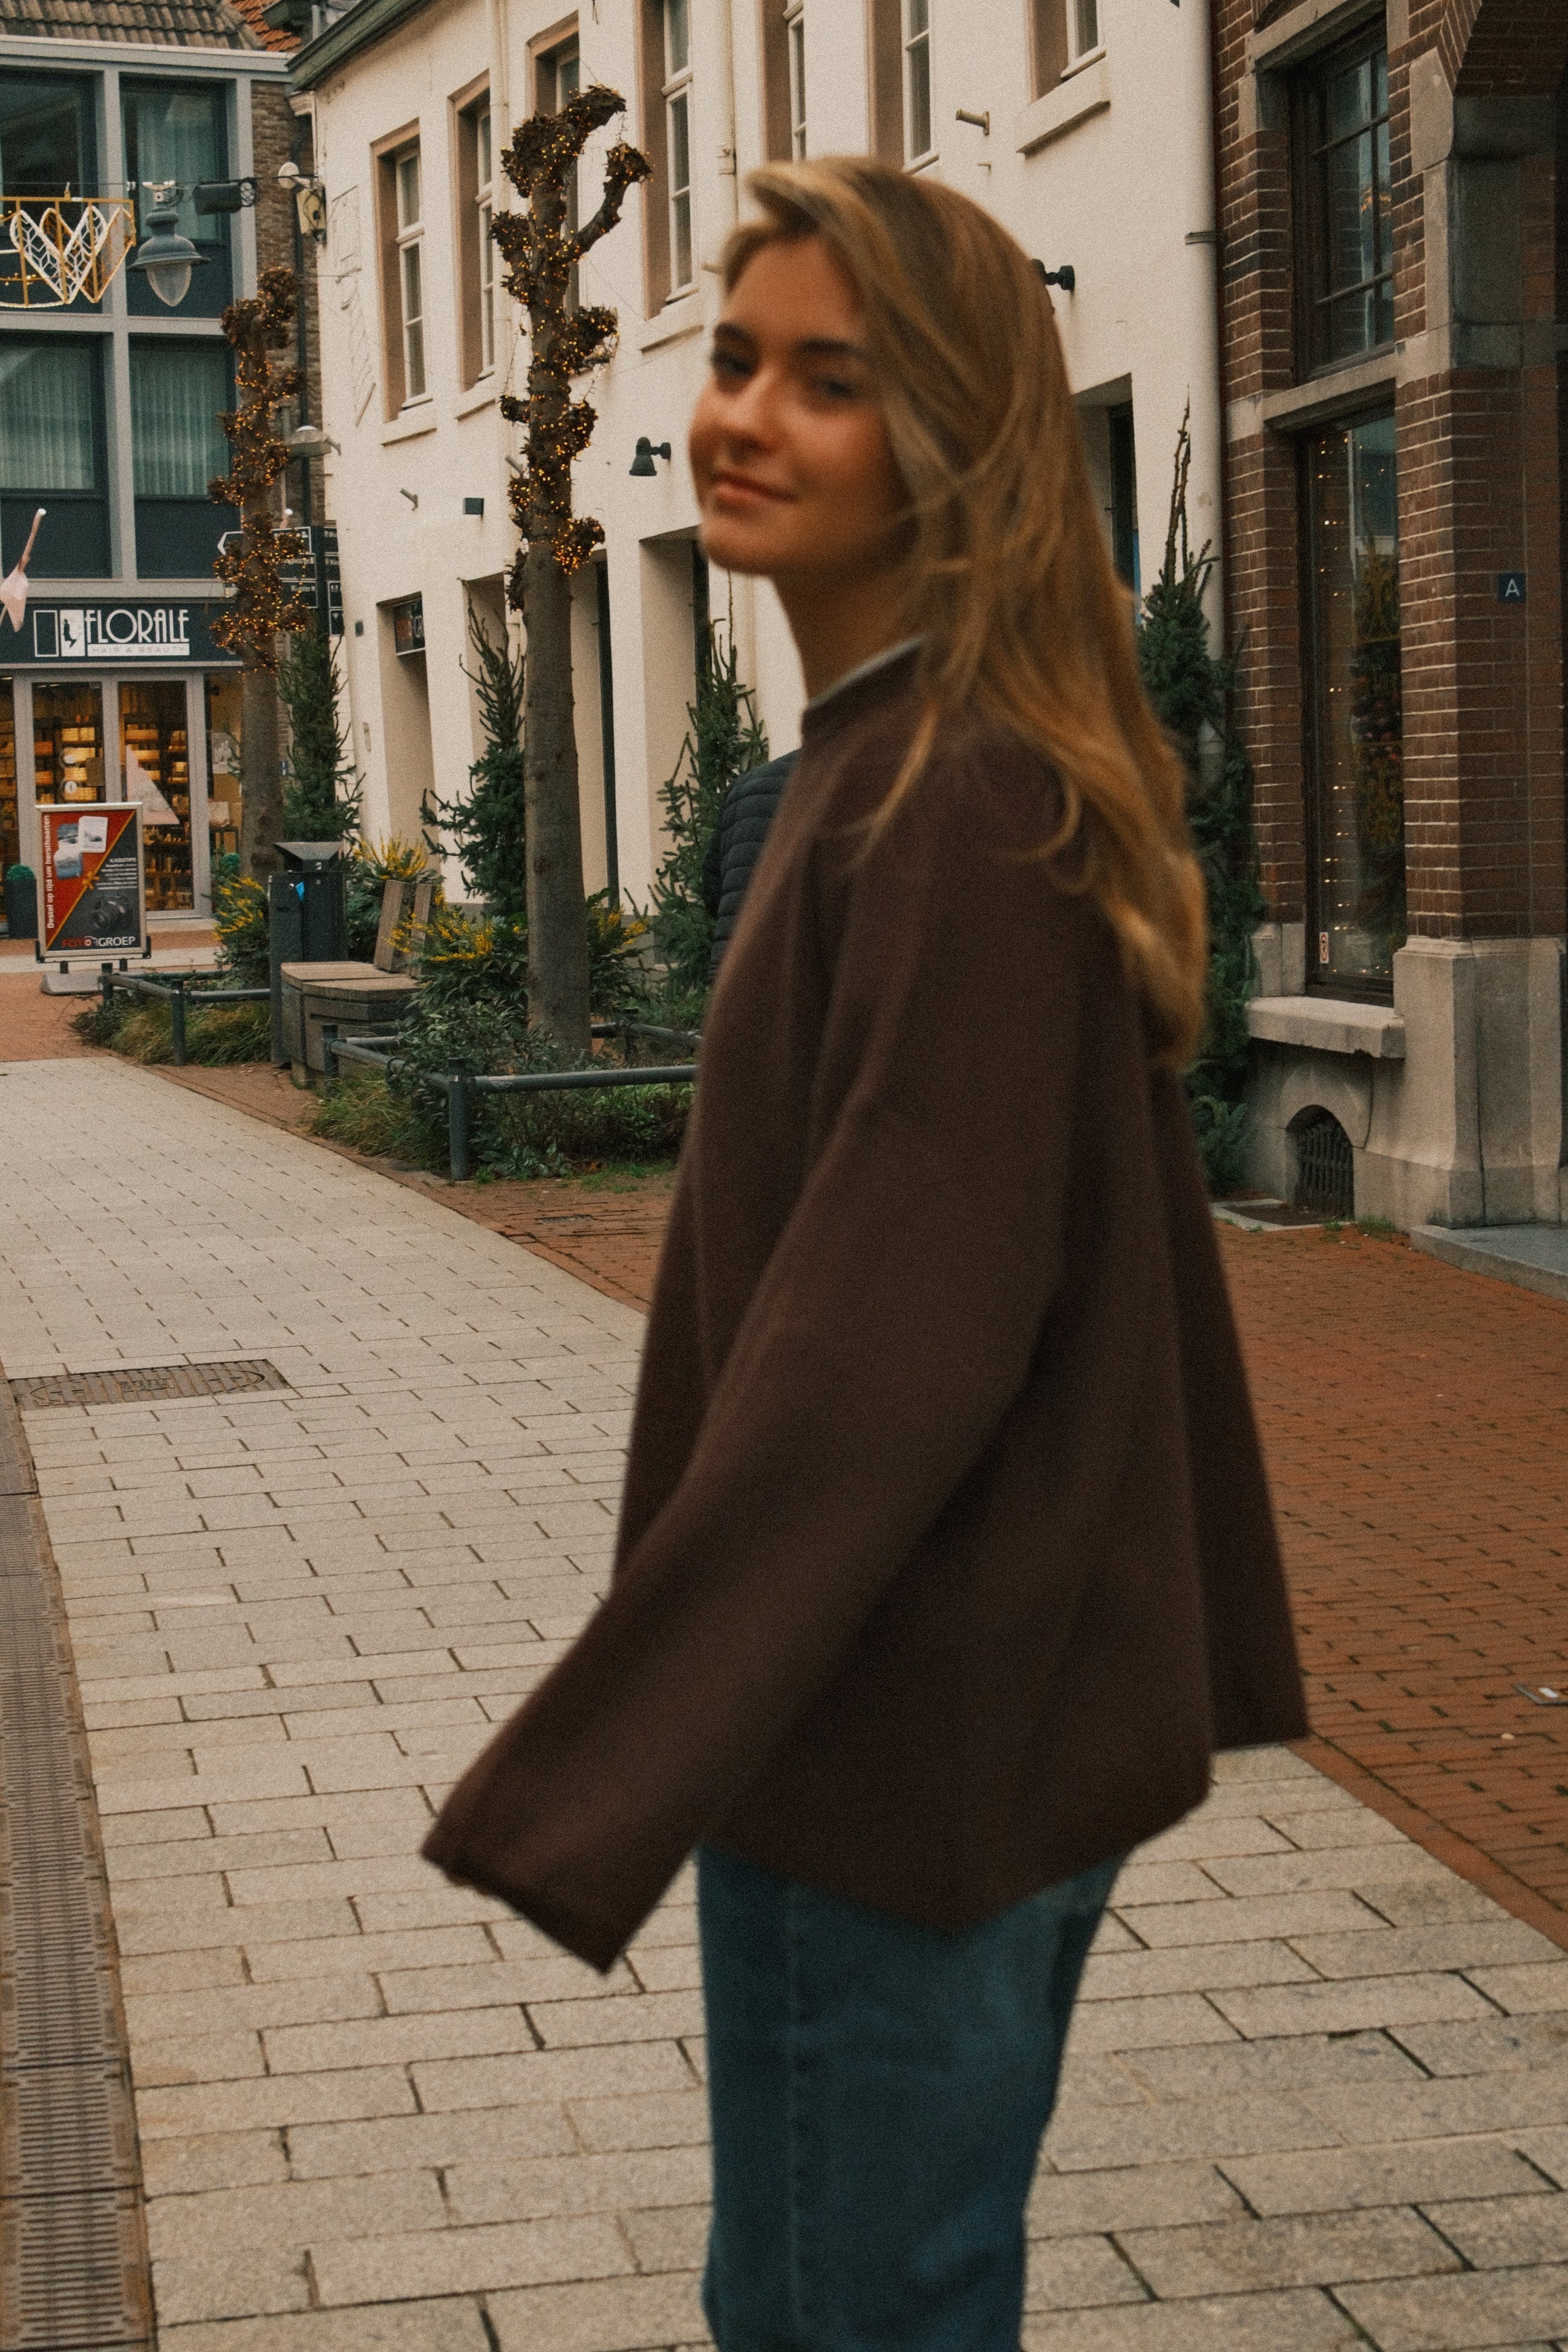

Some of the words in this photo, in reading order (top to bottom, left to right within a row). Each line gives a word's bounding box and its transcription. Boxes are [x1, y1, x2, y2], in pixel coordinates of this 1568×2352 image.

[1504, 578, 1520, 597] A
[85, 609, 189, 643] FLORALE
[46, 866, 52, 877] uw
[47, 893, 54, 903] op
